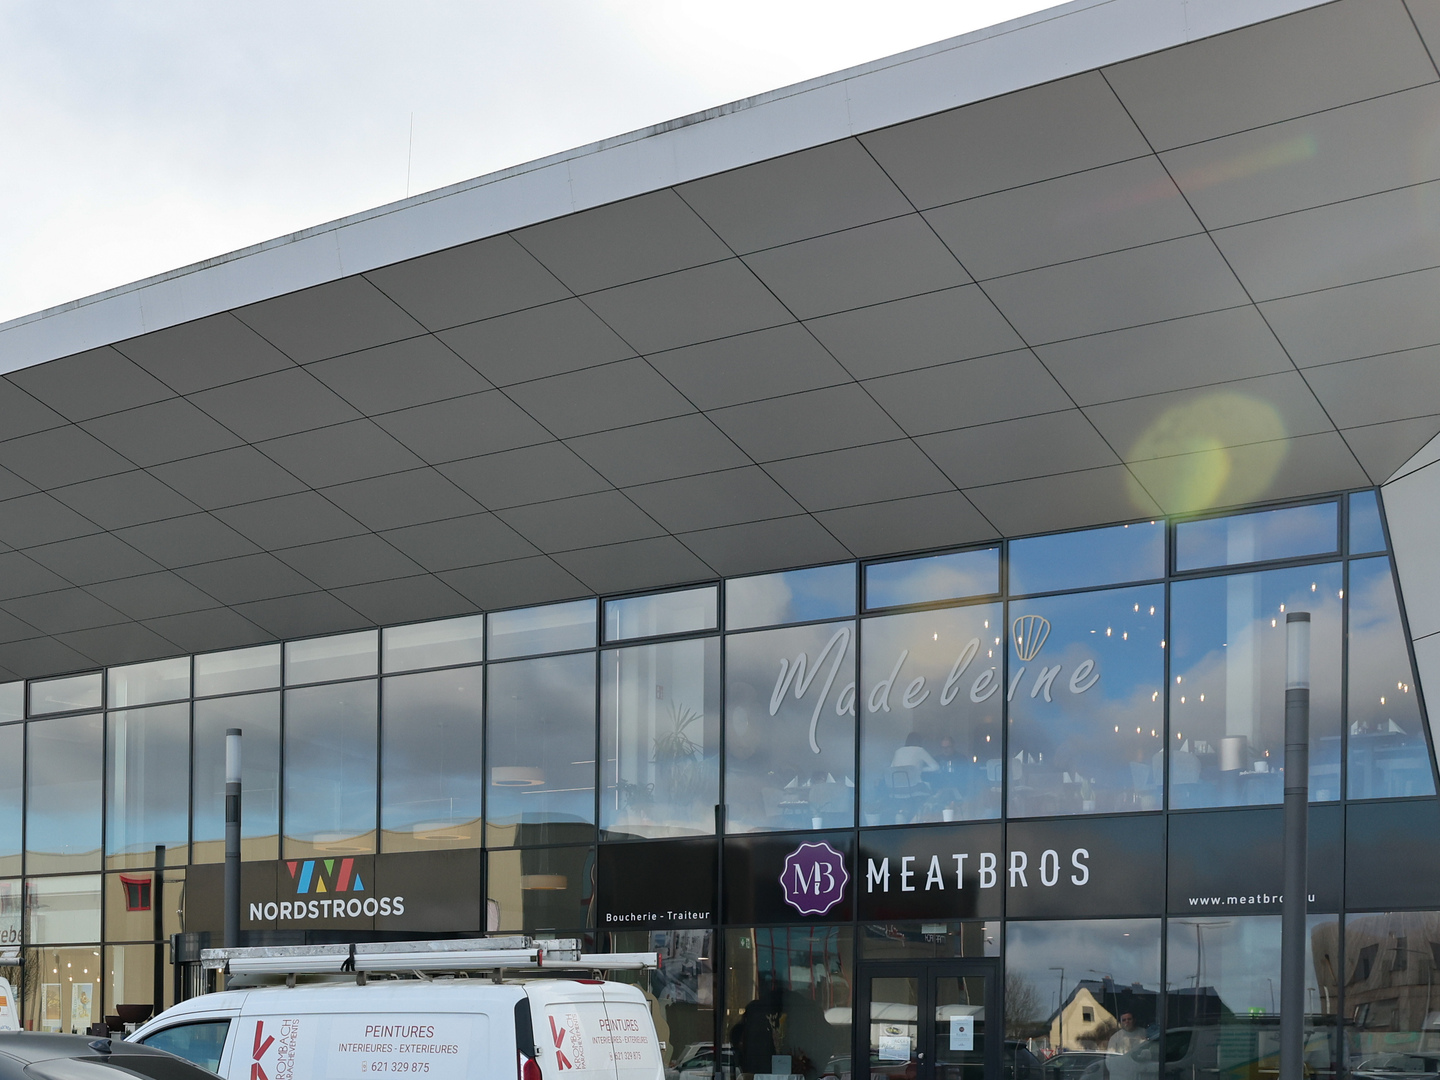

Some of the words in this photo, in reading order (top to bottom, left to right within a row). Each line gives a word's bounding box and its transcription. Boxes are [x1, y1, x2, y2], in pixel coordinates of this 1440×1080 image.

[769, 627, 1100, 753] Madeleine
[866, 848, 1090, 893] MEATBROS
[1189, 894, 1315, 905] www.meatbru
[249, 896, 405, 921] NORDSTROOSS
[606, 912, 657, 922] Boucherie
[667, 911, 710, 920] Traiteur
[599, 1019, 640, 1031] PEINTURES
[365, 1025, 435, 1038] PEINTURES
[565, 1013, 581, 1070] KROMBACH
[592, 1036, 623, 1044] INTERIEURES
[624, 1036, 648, 1044] EXTERIEURES
[338, 1043, 393, 1053] INTERIEURES
[399, 1044, 459, 1054] EXTERIEURES
[371, 1061, 388, 1072] 621
[391, 1062, 409, 1073] 329
[411, 1062, 430, 1073] 875
